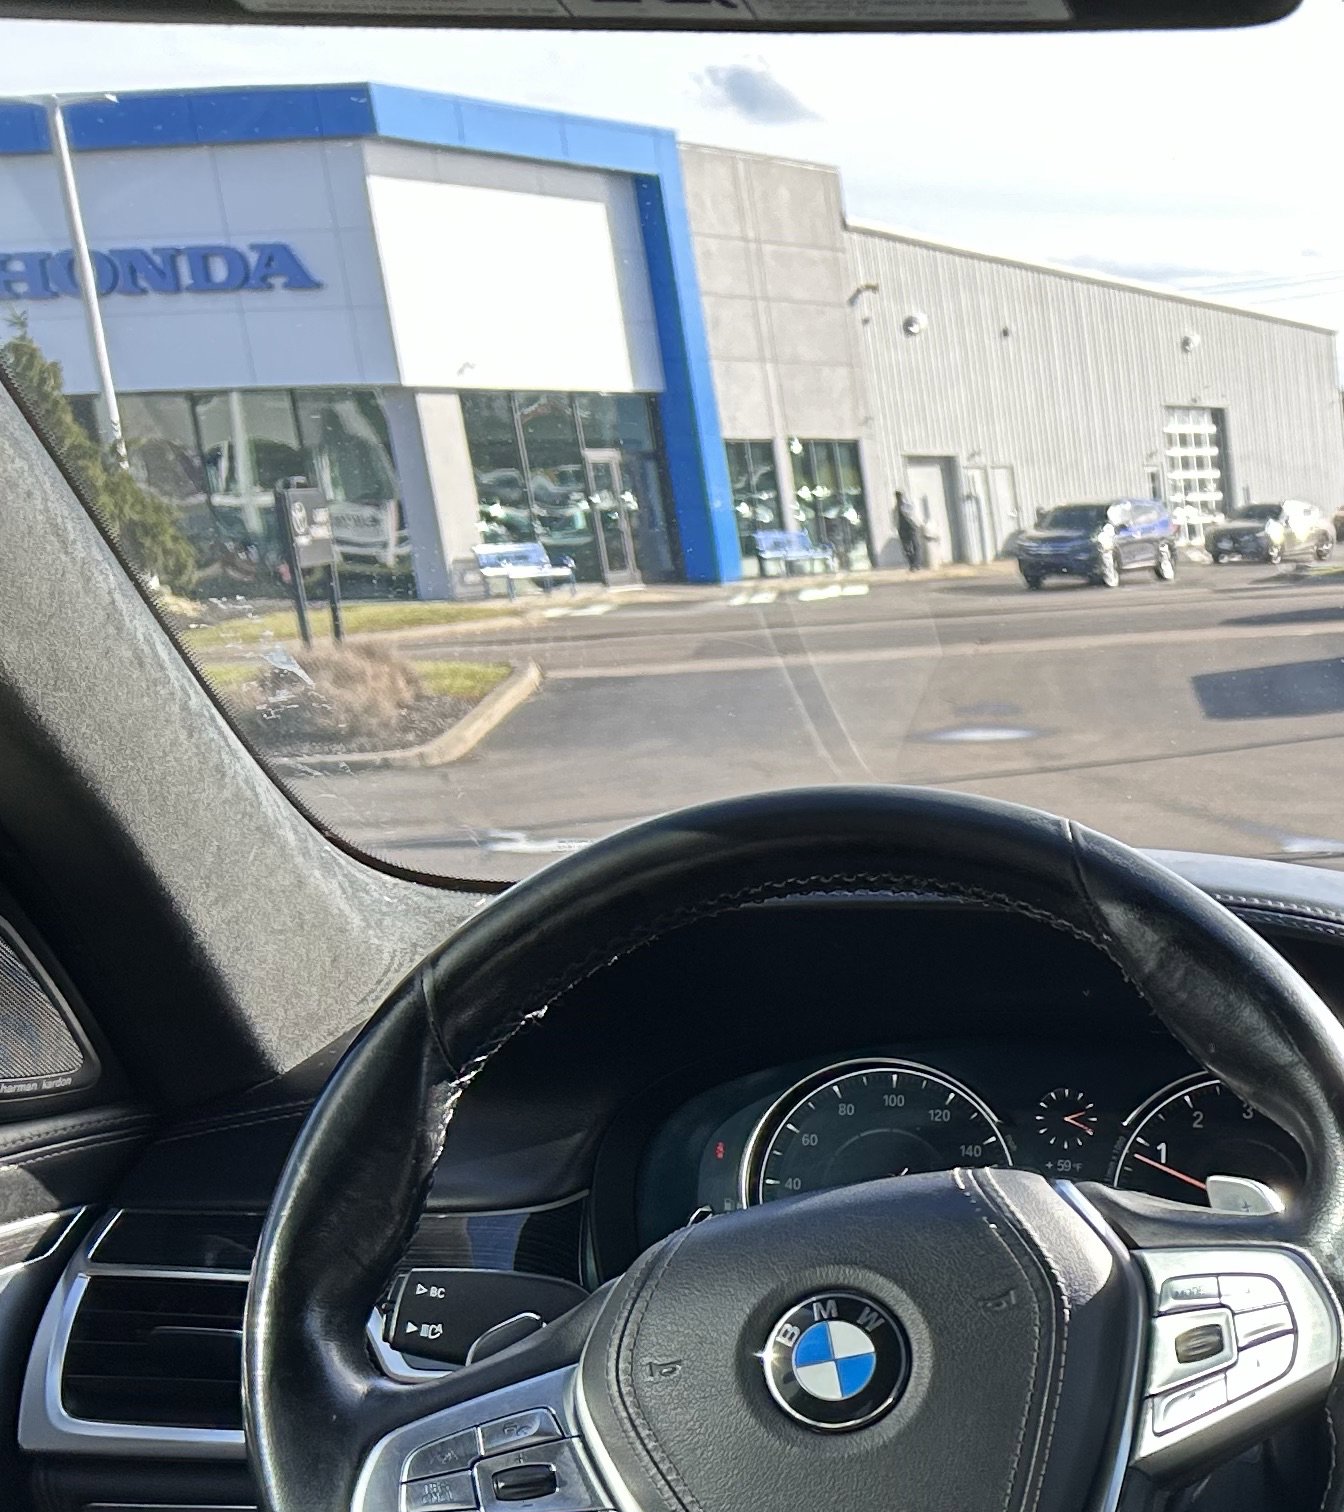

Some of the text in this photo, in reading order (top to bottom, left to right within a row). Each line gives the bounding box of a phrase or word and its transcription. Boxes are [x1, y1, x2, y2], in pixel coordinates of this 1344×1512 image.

[0, 242, 324, 299] HONDA
[882, 1094, 905, 1107] 100
[838, 1104, 855, 1116] 80
[928, 1110, 951, 1122] 120
[1192, 1112, 1204, 1129] 2
[802, 1134, 819, 1146] 60
[960, 1145, 982, 1158] 140
[1156, 1142, 1168, 1164] 1
[1056, 1159, 1073, 1173] 59
[784, 1178, 801, 1191] 40
[429, 1286, 447, 1299] BC
[775, 1299, 886, 1349] BMW
